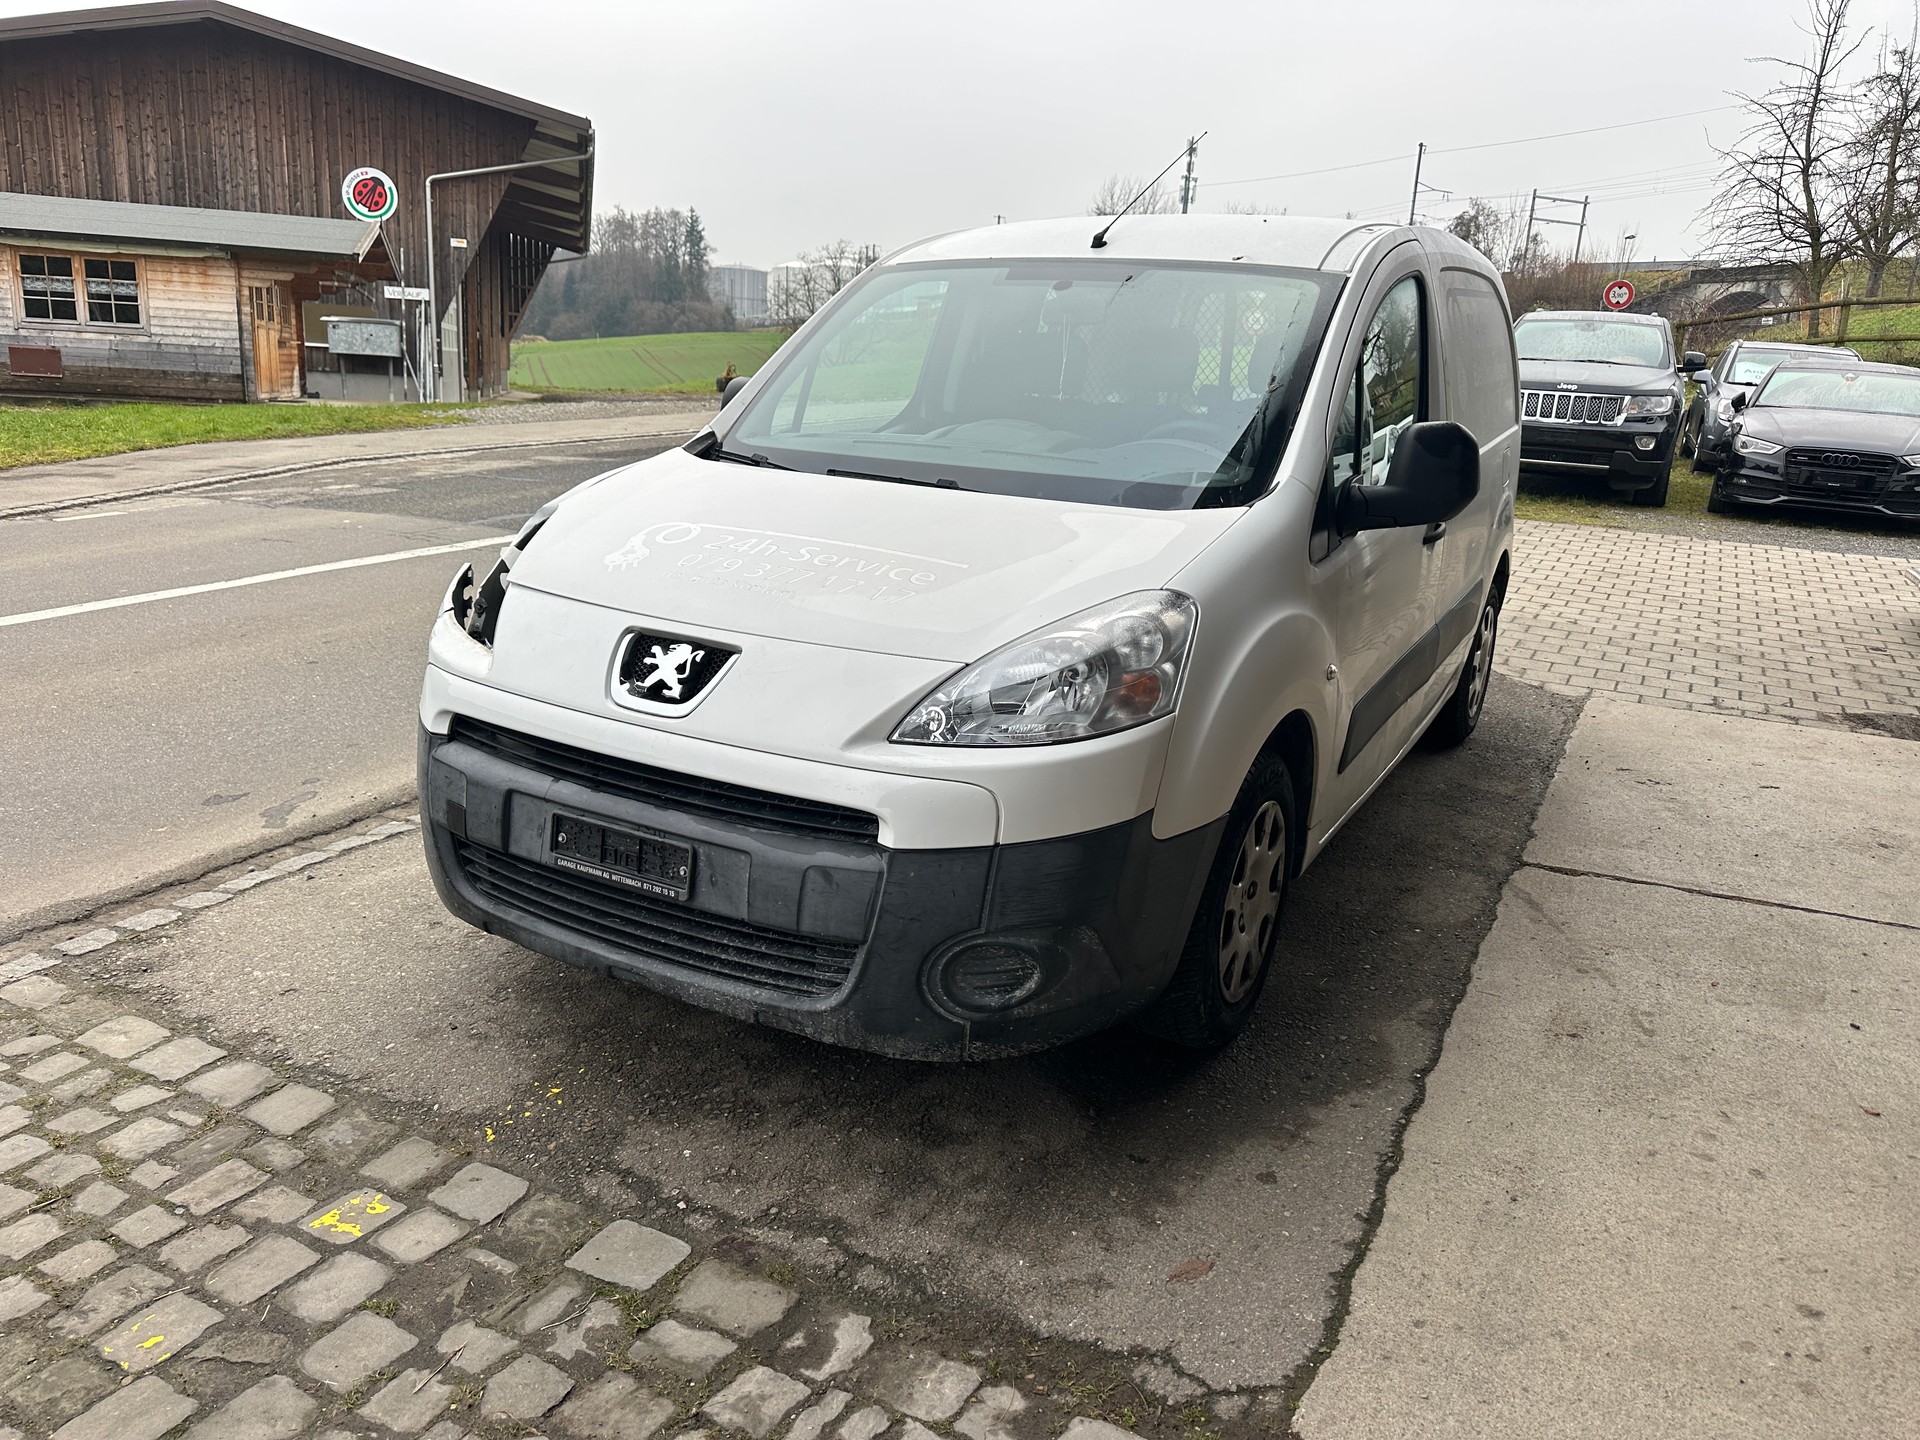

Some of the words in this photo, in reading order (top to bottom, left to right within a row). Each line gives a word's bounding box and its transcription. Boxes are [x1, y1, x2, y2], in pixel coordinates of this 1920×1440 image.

[1556, 382, 1578, 391] Jeep
[677, 553, 744, 573] 079
[743, 562, 816, 584] 377
[820, 575, 867, 594] 17
[866, 585, 918, 608] 17
[702, 534, 937, 587] 24h-Service
[557, 858, 577, 870] GARAGE
[576, 863, 603, 879] KAUFMANN
[602, 871, 610, 879] AG
[611, 874, 642, 888] WITTENBACH
[643, 882, 652, 890] 071
